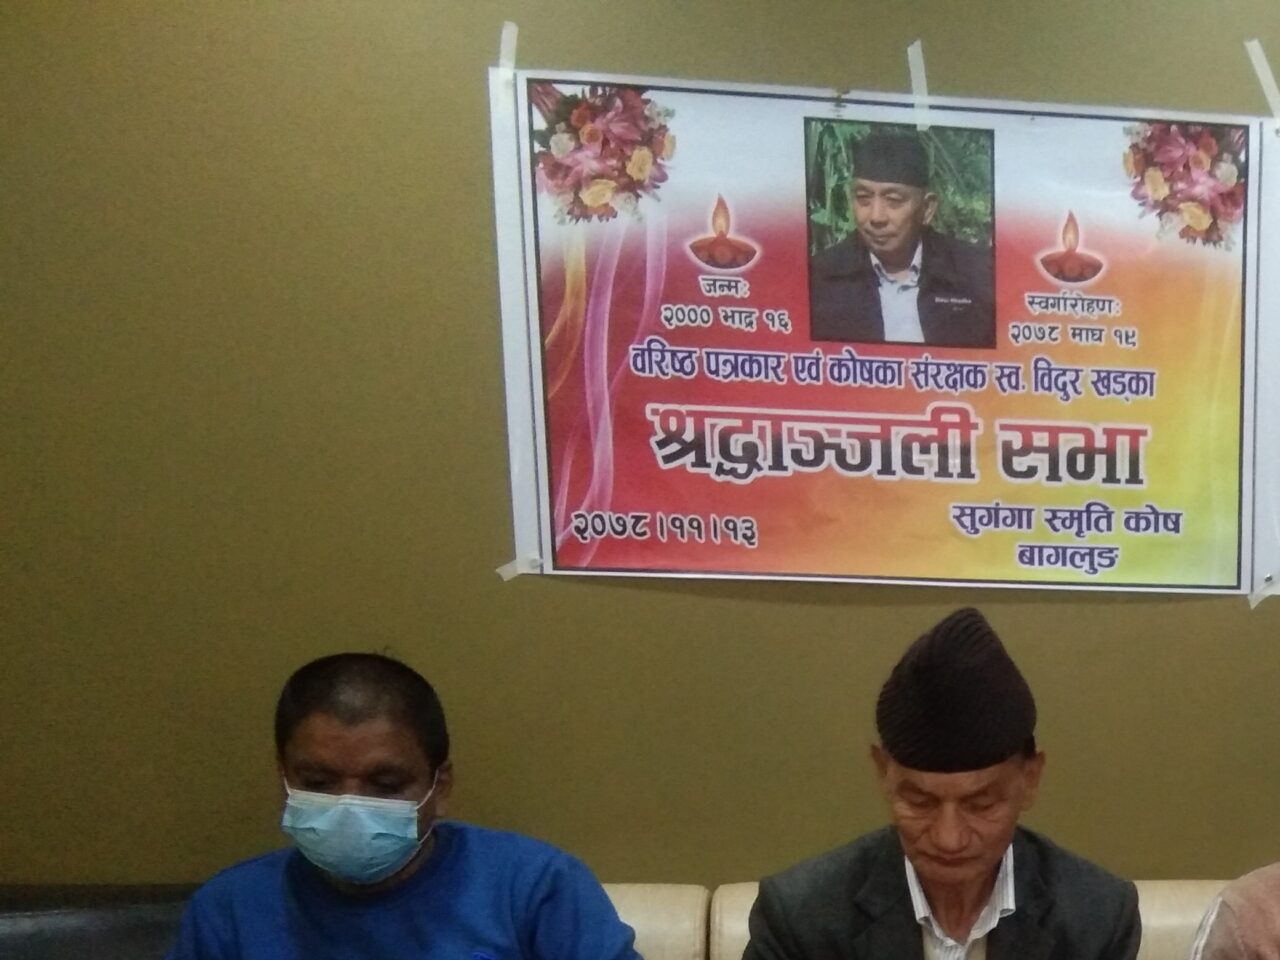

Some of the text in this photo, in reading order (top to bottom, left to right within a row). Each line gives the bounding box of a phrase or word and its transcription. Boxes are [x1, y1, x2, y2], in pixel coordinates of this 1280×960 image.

[663, 306, 789, 330] २००० भाद्र १६
[1011, 324, 1059, 343] २०७८
[1071, 326, 1104, 343] माघ
[632, 338, 697, 376] वरिष्ठ
[704, 350, 786, 382] पत्रकार
[793, 350, 821, 382] एवं
[829, 348, 904, 386] कोषका
[911, 356, 988, 391] संरक्षक
[1091, 369, 1156, 402] खड्का
[999, 422, 1148, 485] सभा
[952, 501, 1183, 538] सुगंगा स्मृति कोष
[1018, 544, 1119, 575] बागलुङ
